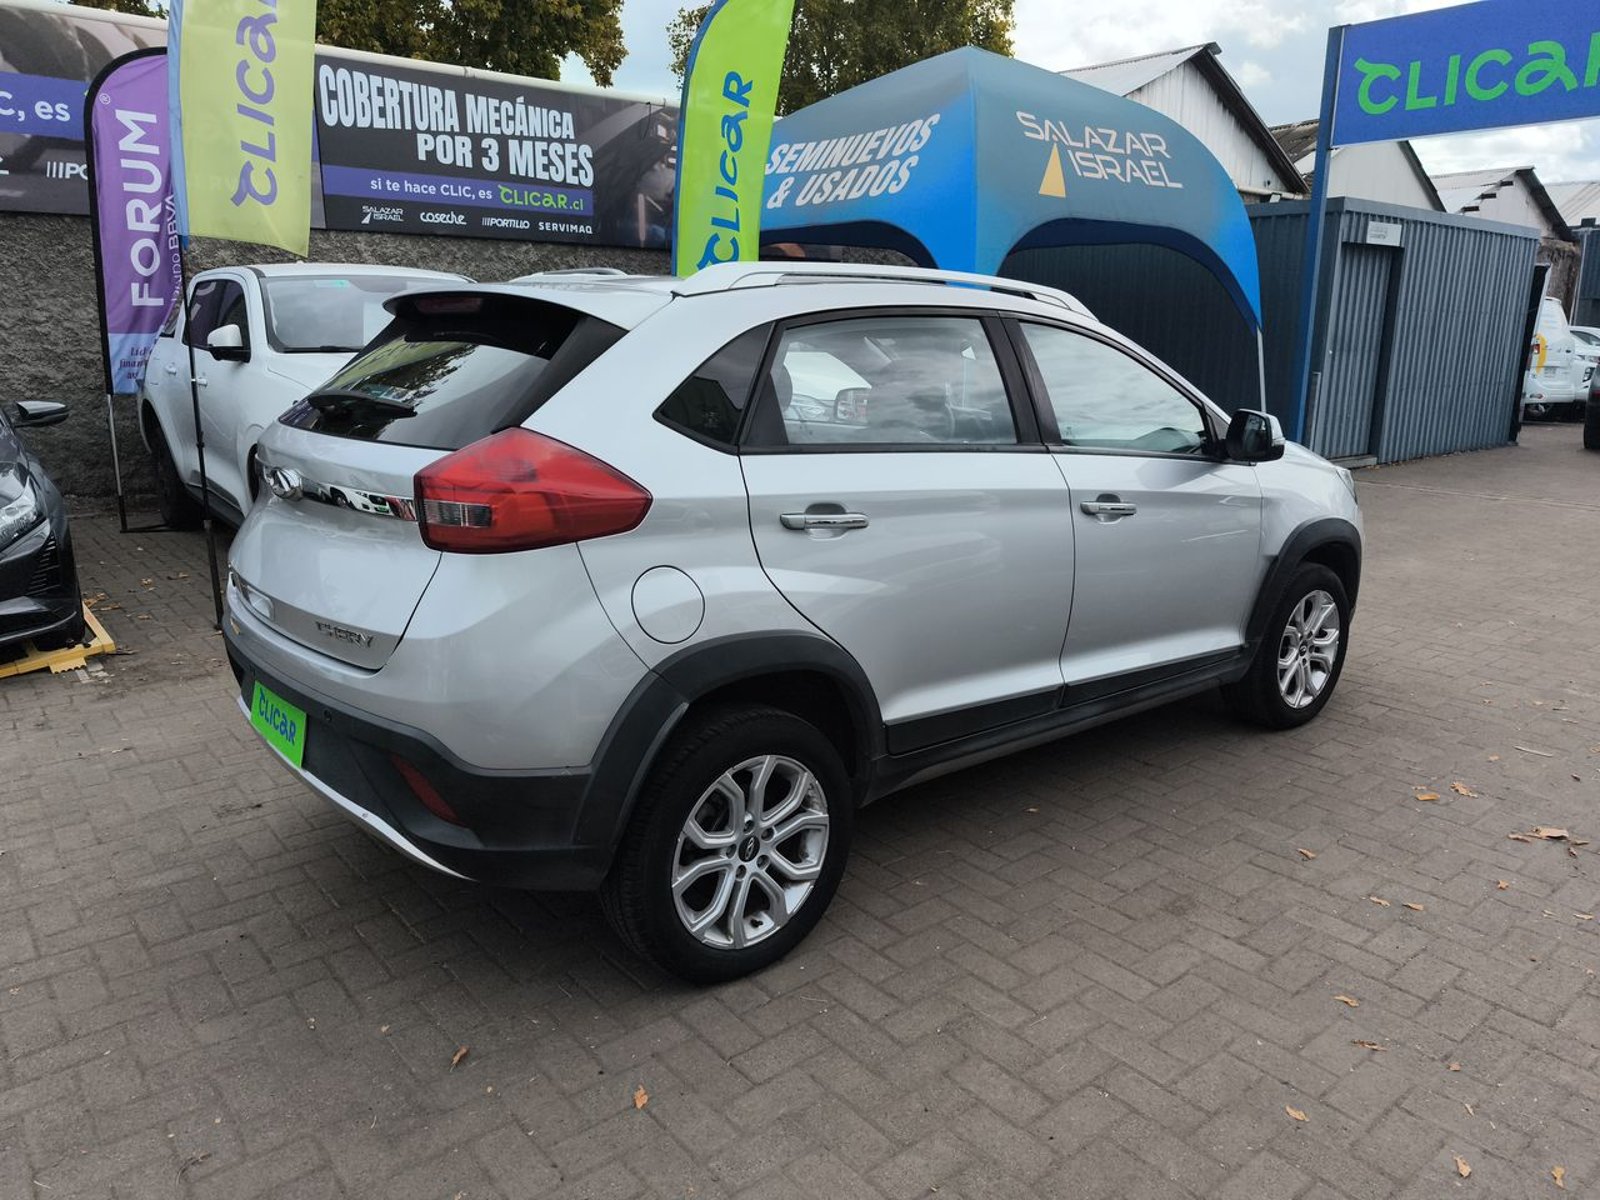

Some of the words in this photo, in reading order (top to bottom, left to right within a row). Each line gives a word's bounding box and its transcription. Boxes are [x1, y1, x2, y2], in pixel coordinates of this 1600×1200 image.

[34, 100, 71, 122] es
[319, 64, 459, 132] COBERTURA
[465, 92, 575, 140] MECÁNICA
[765, 113, 940, 175] SEMINUEVOS
[1016, 110, 1172, 159] SALAZAR
[416, 133, 473, 169] POR
[481, 138, 500, 172] 3
[508, 139, 594, 187] MESES
[1067, 149, 1184, 189] ISRAEL
[370, 178, 381, 190] si
[385, 180, 400, 191] te
[404, 181, 436, 195] hace
[440, 184, 475, 200] CLIC,
[478, 190, 493, 200] es
[766, 176, 795, 210] &
[795, 155, 919, 207] USADOS
[115, 109, 164, 306] FORUM
[362, 205, 403, 215] SALAZAR
[373, 213, 404, 222] ISRAEL
[420, 211, 467, 225] coseche
[538, 222, 593, 234] SERVIMAQ
